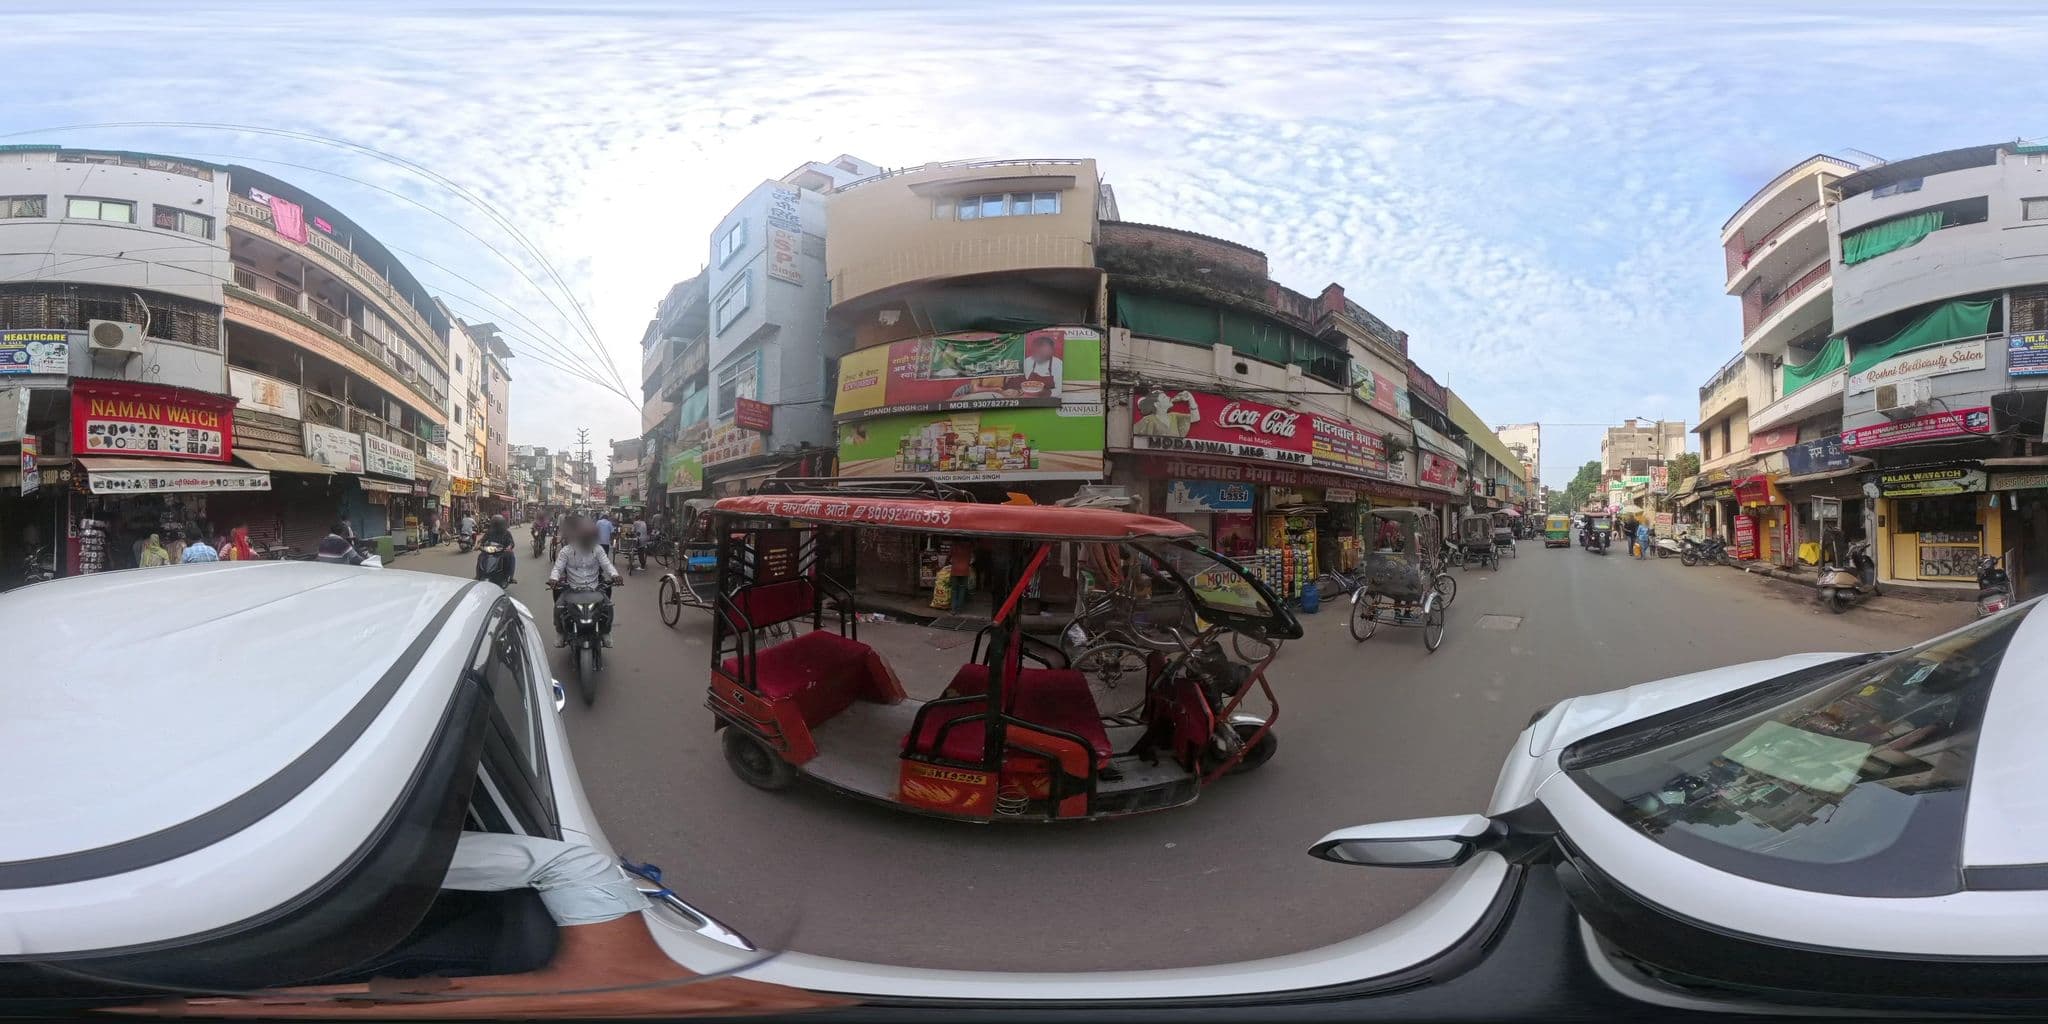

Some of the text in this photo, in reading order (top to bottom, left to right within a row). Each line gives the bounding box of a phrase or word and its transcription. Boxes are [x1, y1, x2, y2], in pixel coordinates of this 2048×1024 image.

[4, 333, 66, 342] HEALTHCARE
[1950, 350, 1983, 364] Salon
[91, 399, 218, 428] NAMAN WATCH
[863, 407, 891, 416] CHANDI
[1214, 402, 1300, 438] Coca Cola
[368, 438, 388, 453] TULSI
[1149, 437, 1234, 456] MODANWAL
[1238, 435, 1273, 446] Real Magic
[1881, 472, 1911, 484] PALAK
[1219, 489, 1249, 502] Lassi
